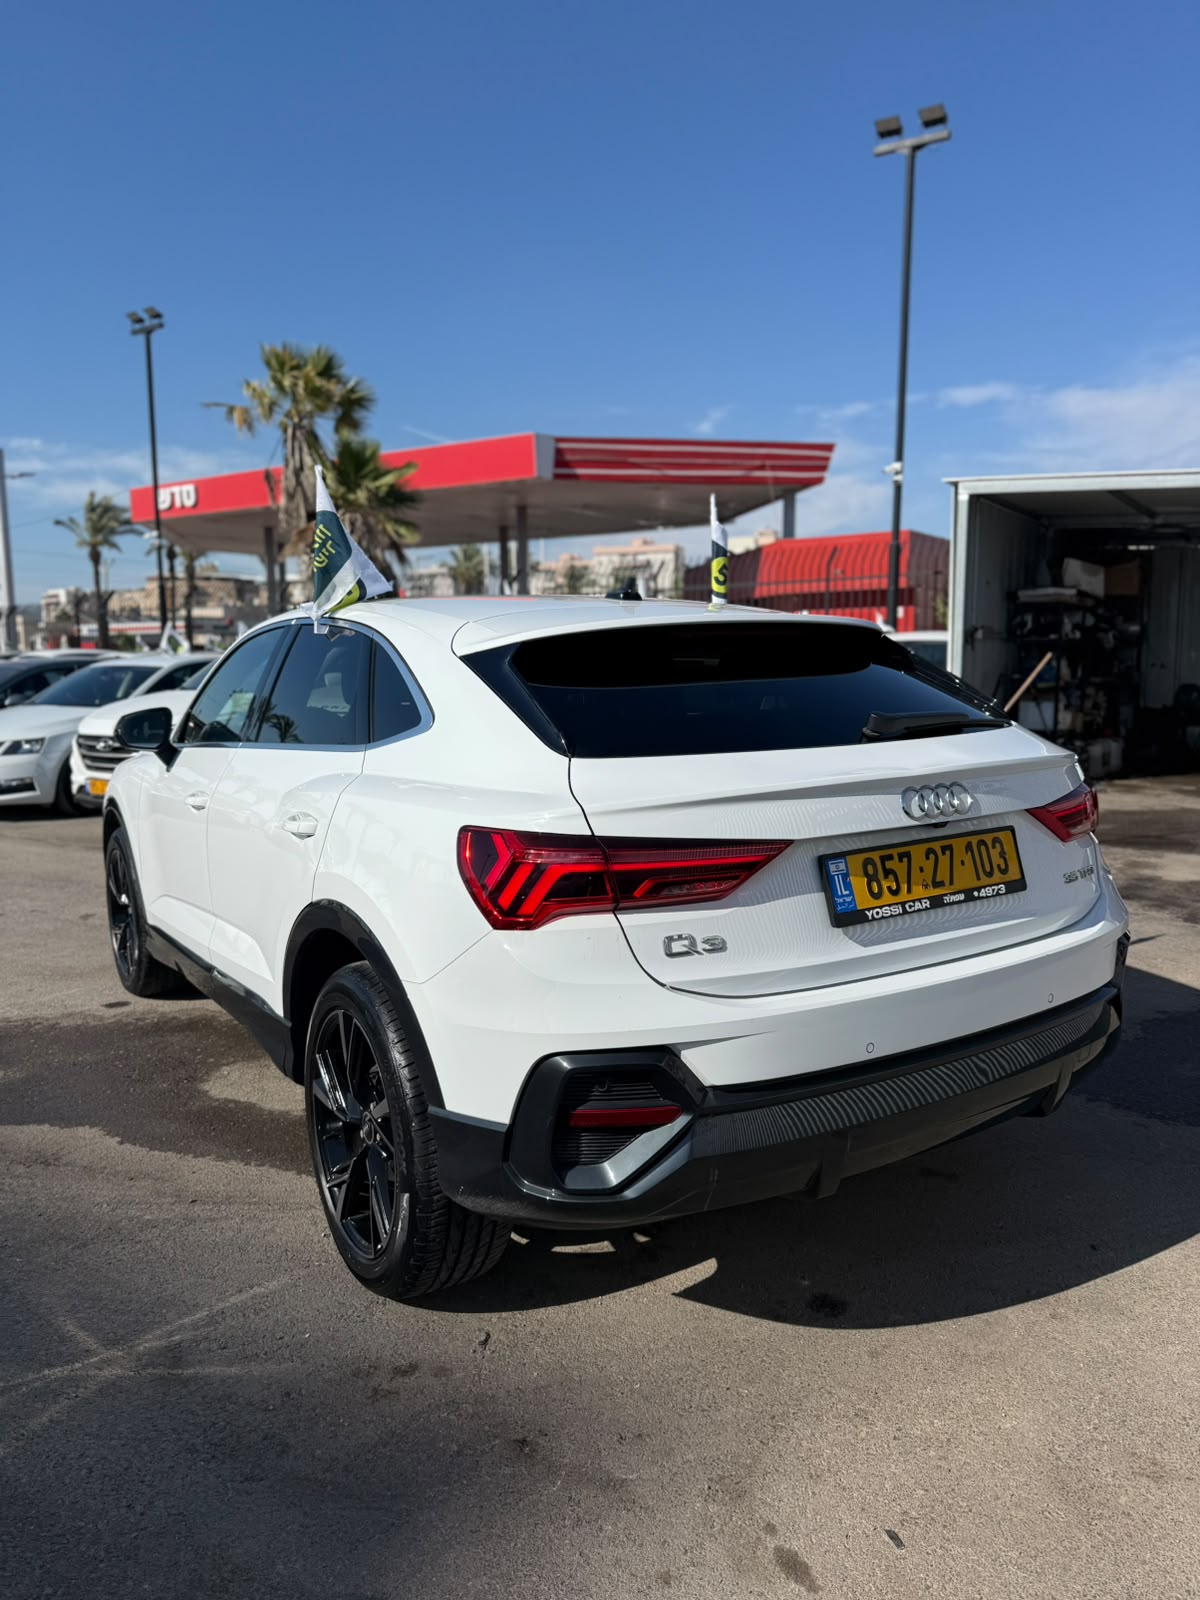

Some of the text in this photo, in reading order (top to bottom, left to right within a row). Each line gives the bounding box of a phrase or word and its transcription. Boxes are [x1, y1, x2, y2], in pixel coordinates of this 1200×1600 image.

[834, 874, 850, 896] IL
[864, 904, 903, 920] YOSSI
[905, 899, 930, 912] CAR
[663, 933, 728, 959] Q3
